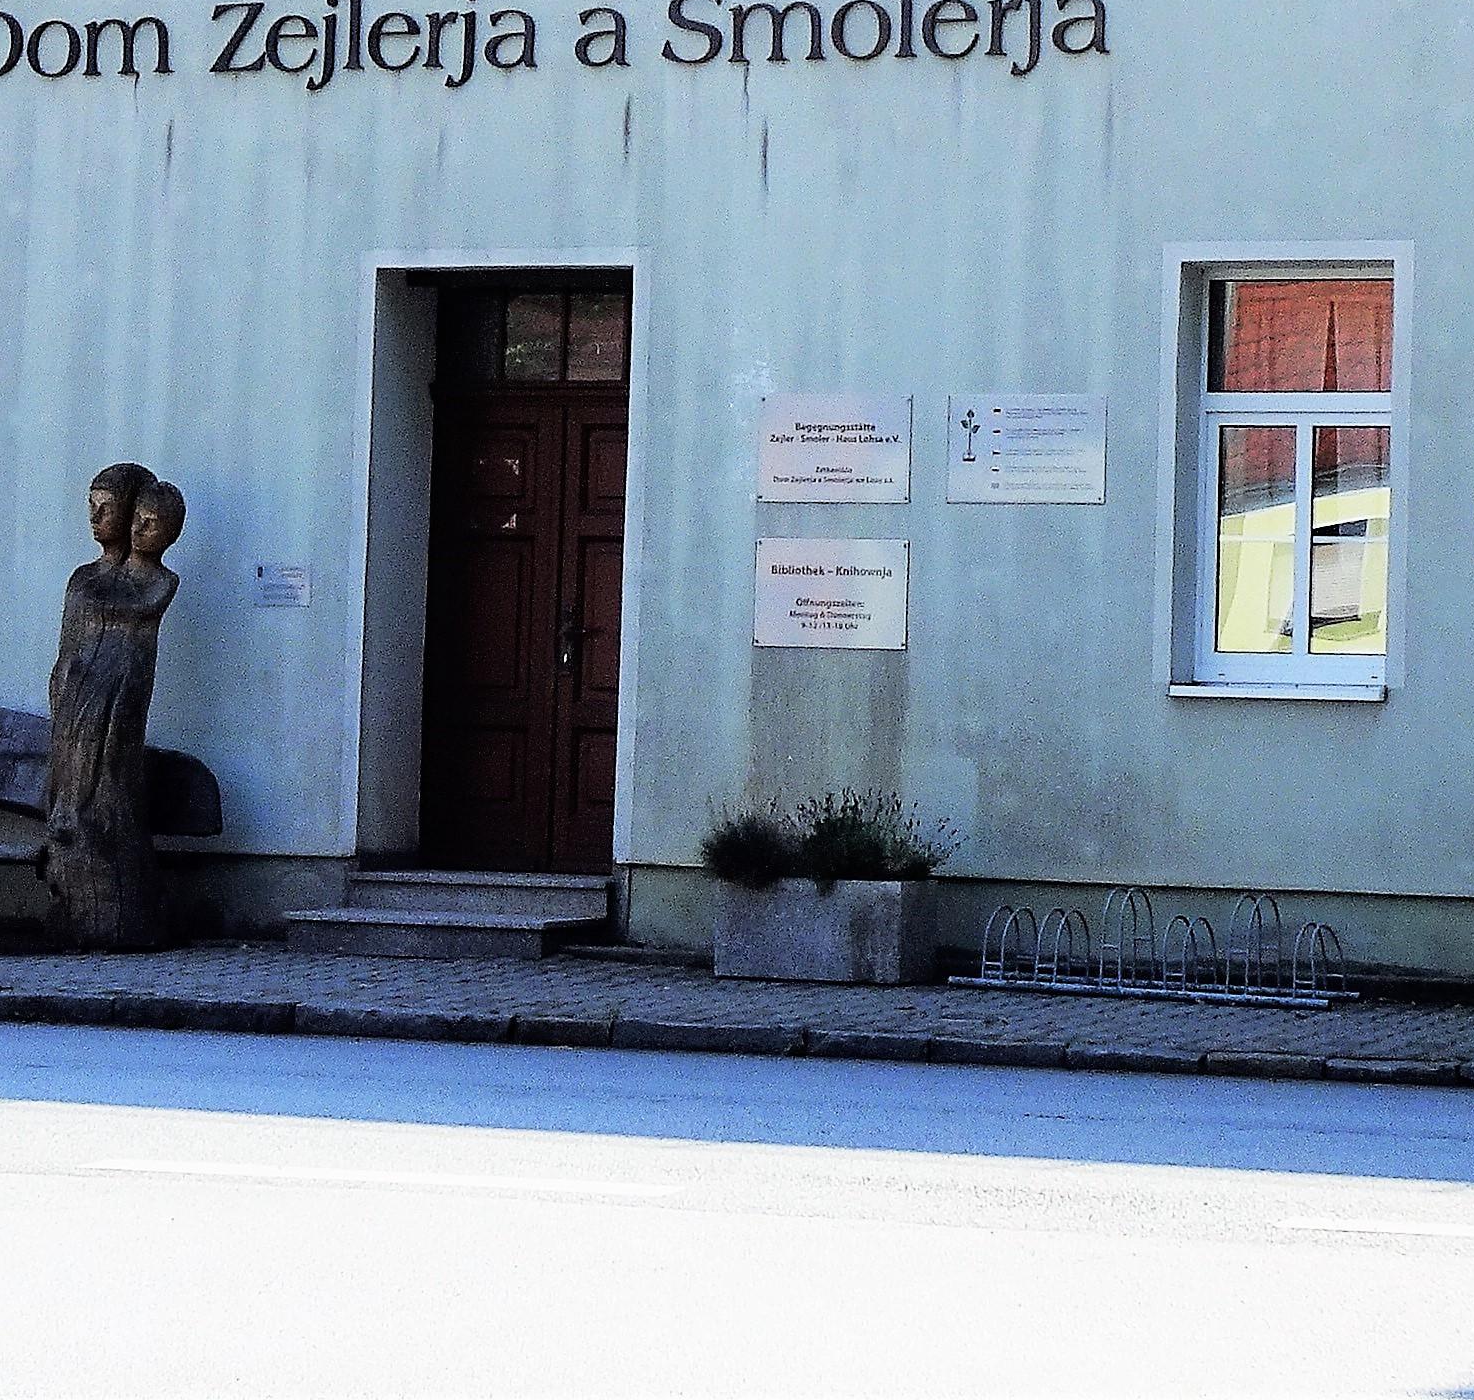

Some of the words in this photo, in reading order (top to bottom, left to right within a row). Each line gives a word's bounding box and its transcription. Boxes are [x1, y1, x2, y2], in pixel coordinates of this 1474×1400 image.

[575, 7, 631, 69] a
[771, 565, 825, 576] Bibliothek
[835, 565, 893, 579] Knihownja
